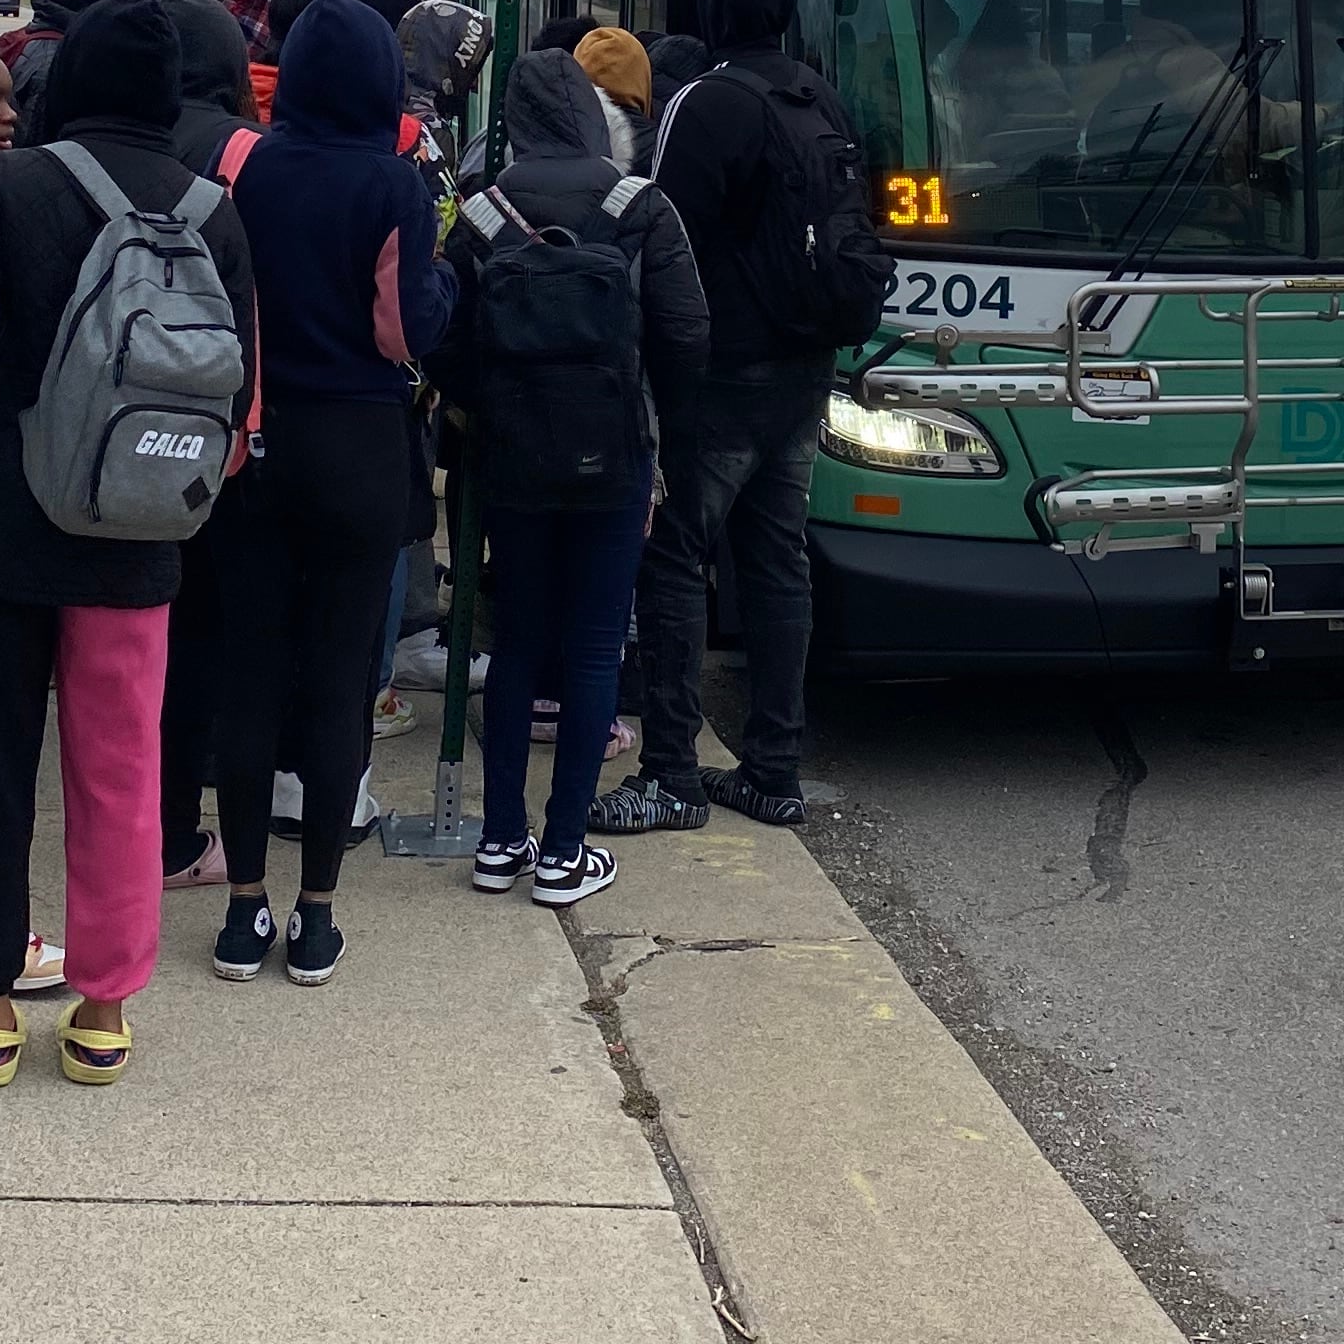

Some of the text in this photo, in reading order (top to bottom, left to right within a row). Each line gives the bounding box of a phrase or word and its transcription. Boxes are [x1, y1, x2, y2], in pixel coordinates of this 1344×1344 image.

[454, 18, 484, 68] ONLY
[888, 176, 950, 225] 31
[134, 429, 205, 460] GALCO
